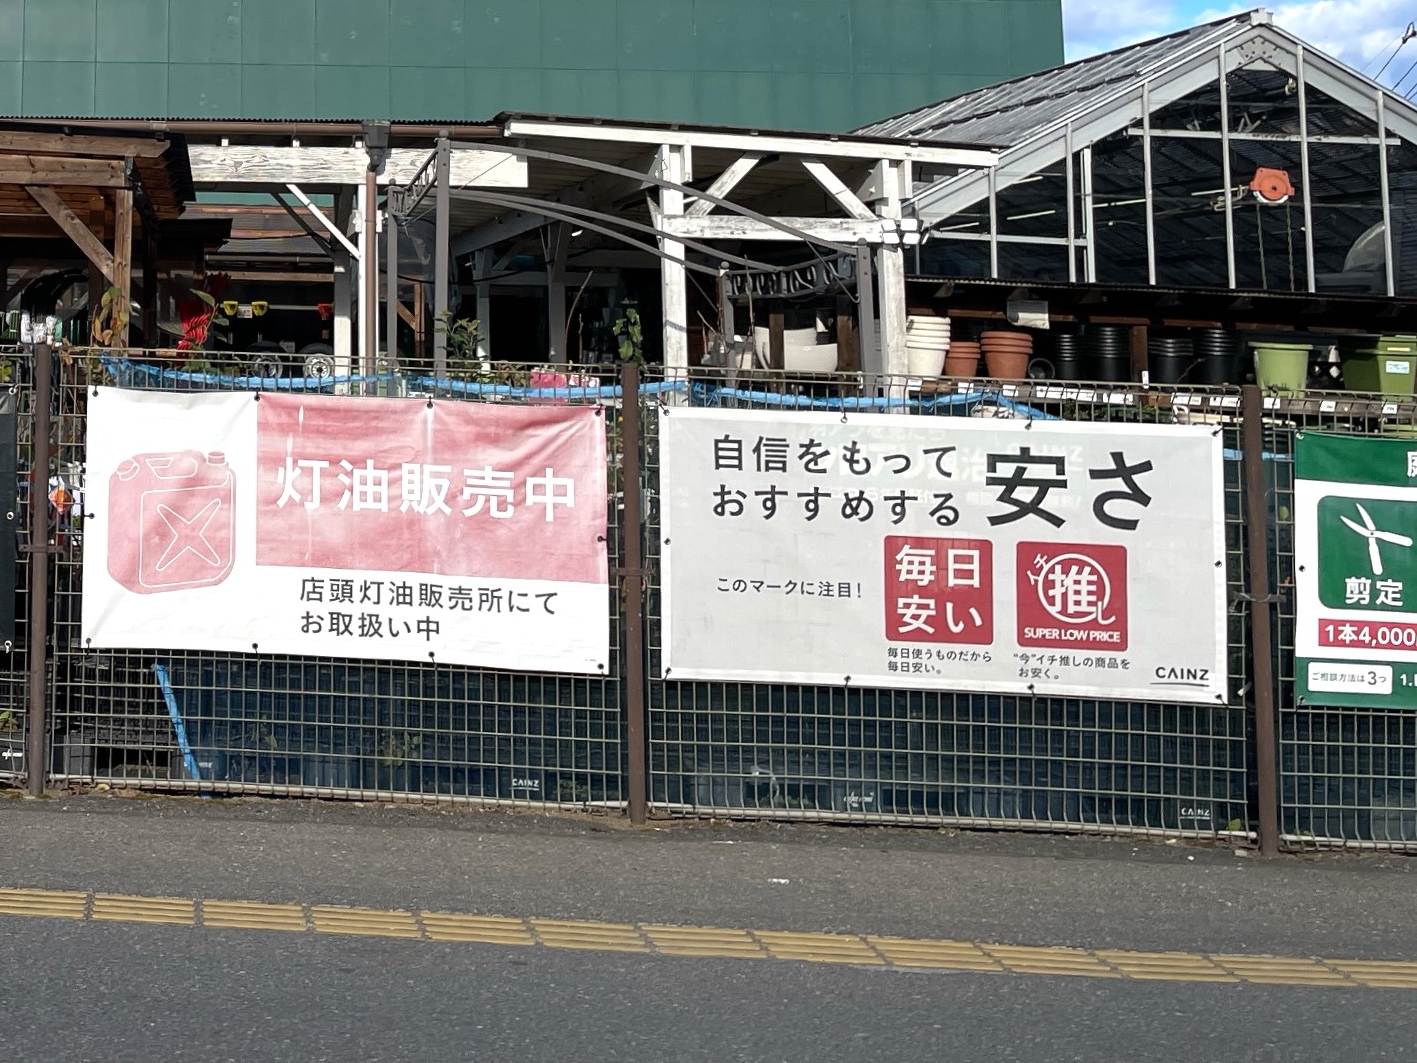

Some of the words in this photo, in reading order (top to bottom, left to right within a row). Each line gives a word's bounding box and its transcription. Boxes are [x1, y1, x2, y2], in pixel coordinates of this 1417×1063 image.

[712, 434, 958, 478] 自信をもって
[275, 457, 577, 523] 灯油販売中
[984, 447, 1154, 531] 安さ
[712, 483, 960, 527] おすすめする
[895, 544, 981, 588] 毎日
[299, 576, 559, 616] 店頭灯油販売所にて
[1345, 577, 1404, 606] 剪定
[299, 611, 441, 642] お取扱い中
[896, 594, 983, 634] 安い
[1024, 627, 1060, 639] SUPER
[1061, 629, 1088, 641] LOW
[1089, 630, 1121, 643] PRICE
[1325, 623, 1417, 647] 1本4,000
[887, 647, 993, 662] 毎日使うものだから
[887, 661, 943, 675] 毎日安い。
[1018, 667, 1060, 680] お安く。
[1155, 667, 1210, 681] CAINZ
[512, 778, 540, 787] CAINZ
